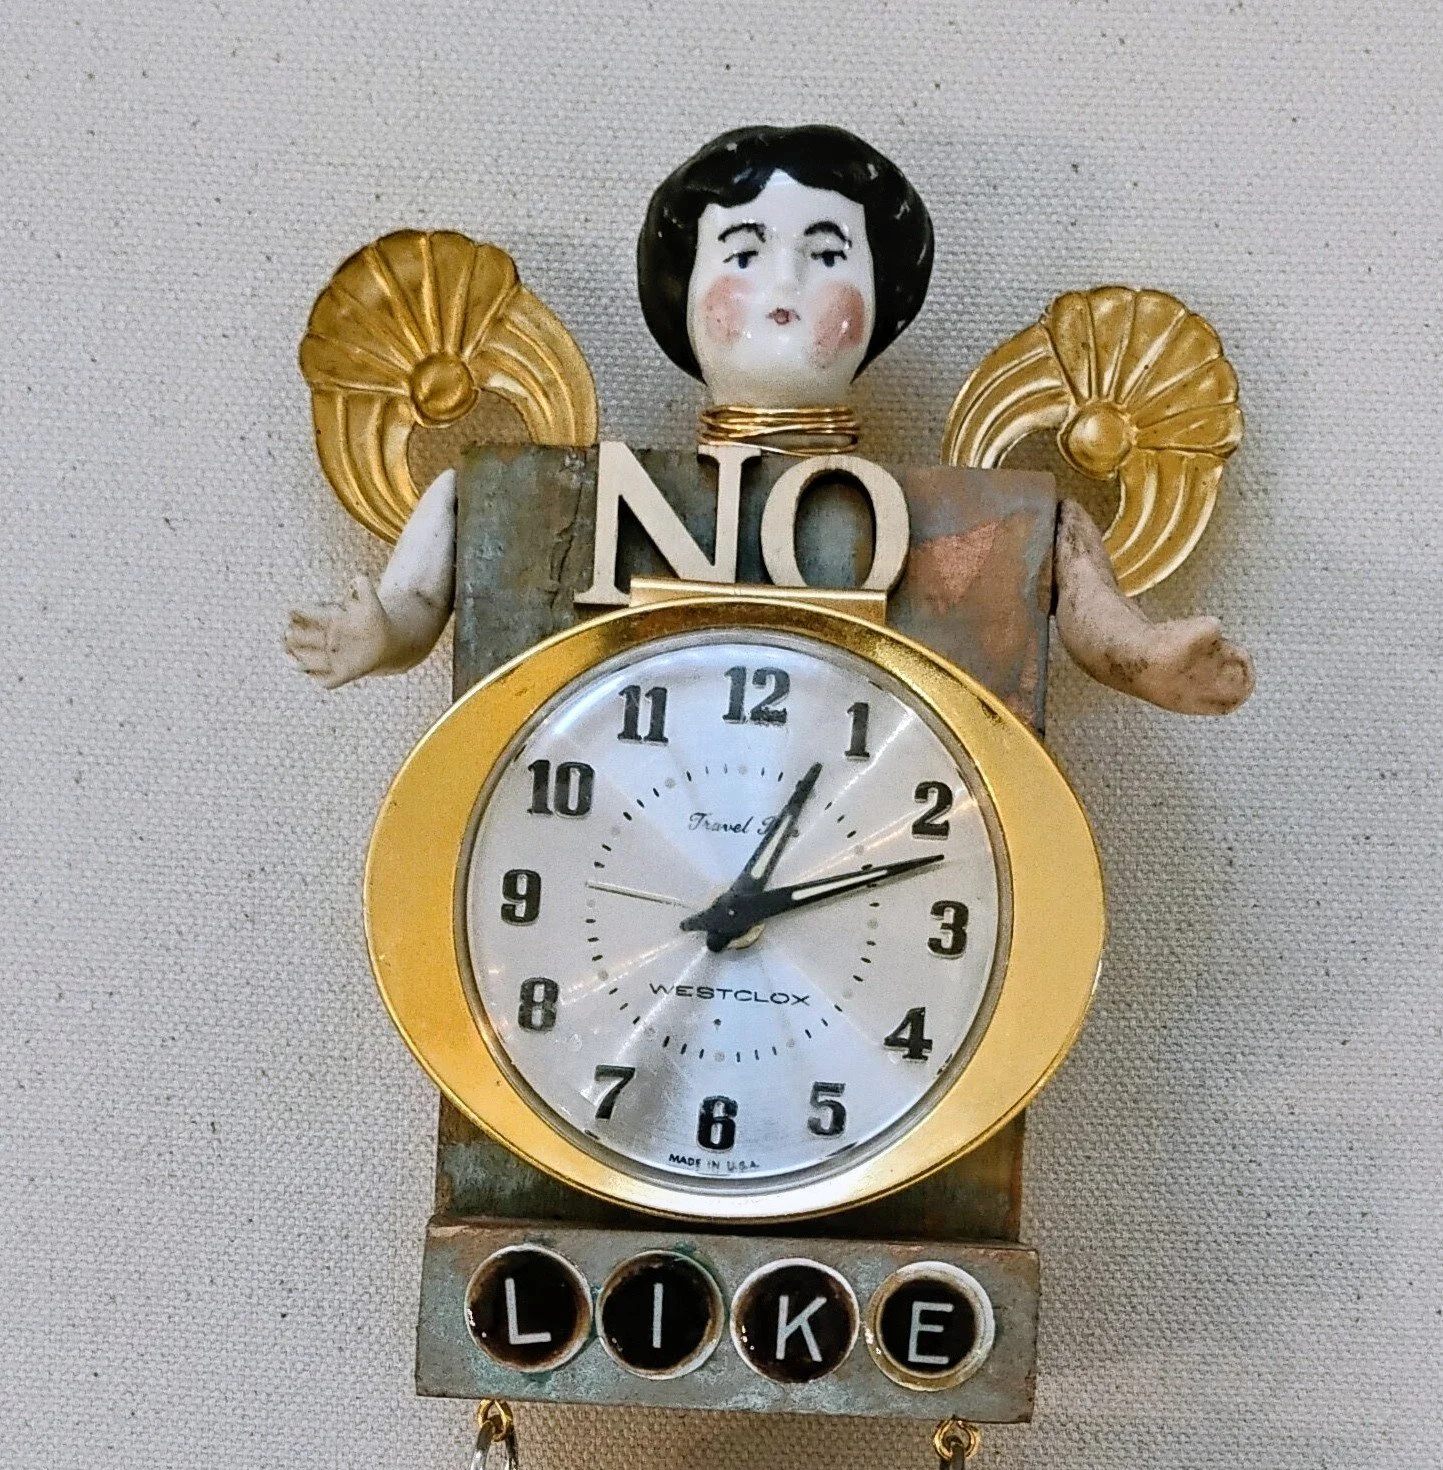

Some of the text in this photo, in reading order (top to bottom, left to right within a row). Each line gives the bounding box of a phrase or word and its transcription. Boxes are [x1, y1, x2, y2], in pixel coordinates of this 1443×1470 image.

[573, 440, 910, 605] NO
[617, 685, 670, 745] 11
[722, 666, 790, 725] 12
[845, 702, 870, 760] 1
[527, 759, 596, 818] 10
[911, 781, 956, 839] 2
[688, 812, 754, 834] Travel
[501, 869, 542, 925] 9
[927, 900, 970, 958] 3
[518, 977, 560, 1032] 8
[649, 982, 811, 1007] WESTCLOX
[883, 1006, 933, 1062] 4
[594, 1064, 636, 1120] 7
[807, 1081, 847, 1137] 5
[696, 1095, 739, 1150] 6
[668, 1153, 701, 1168] MADE
[707, 1160, 720, 1170] IN
[504, 1277, 955, 1365] LIKE
